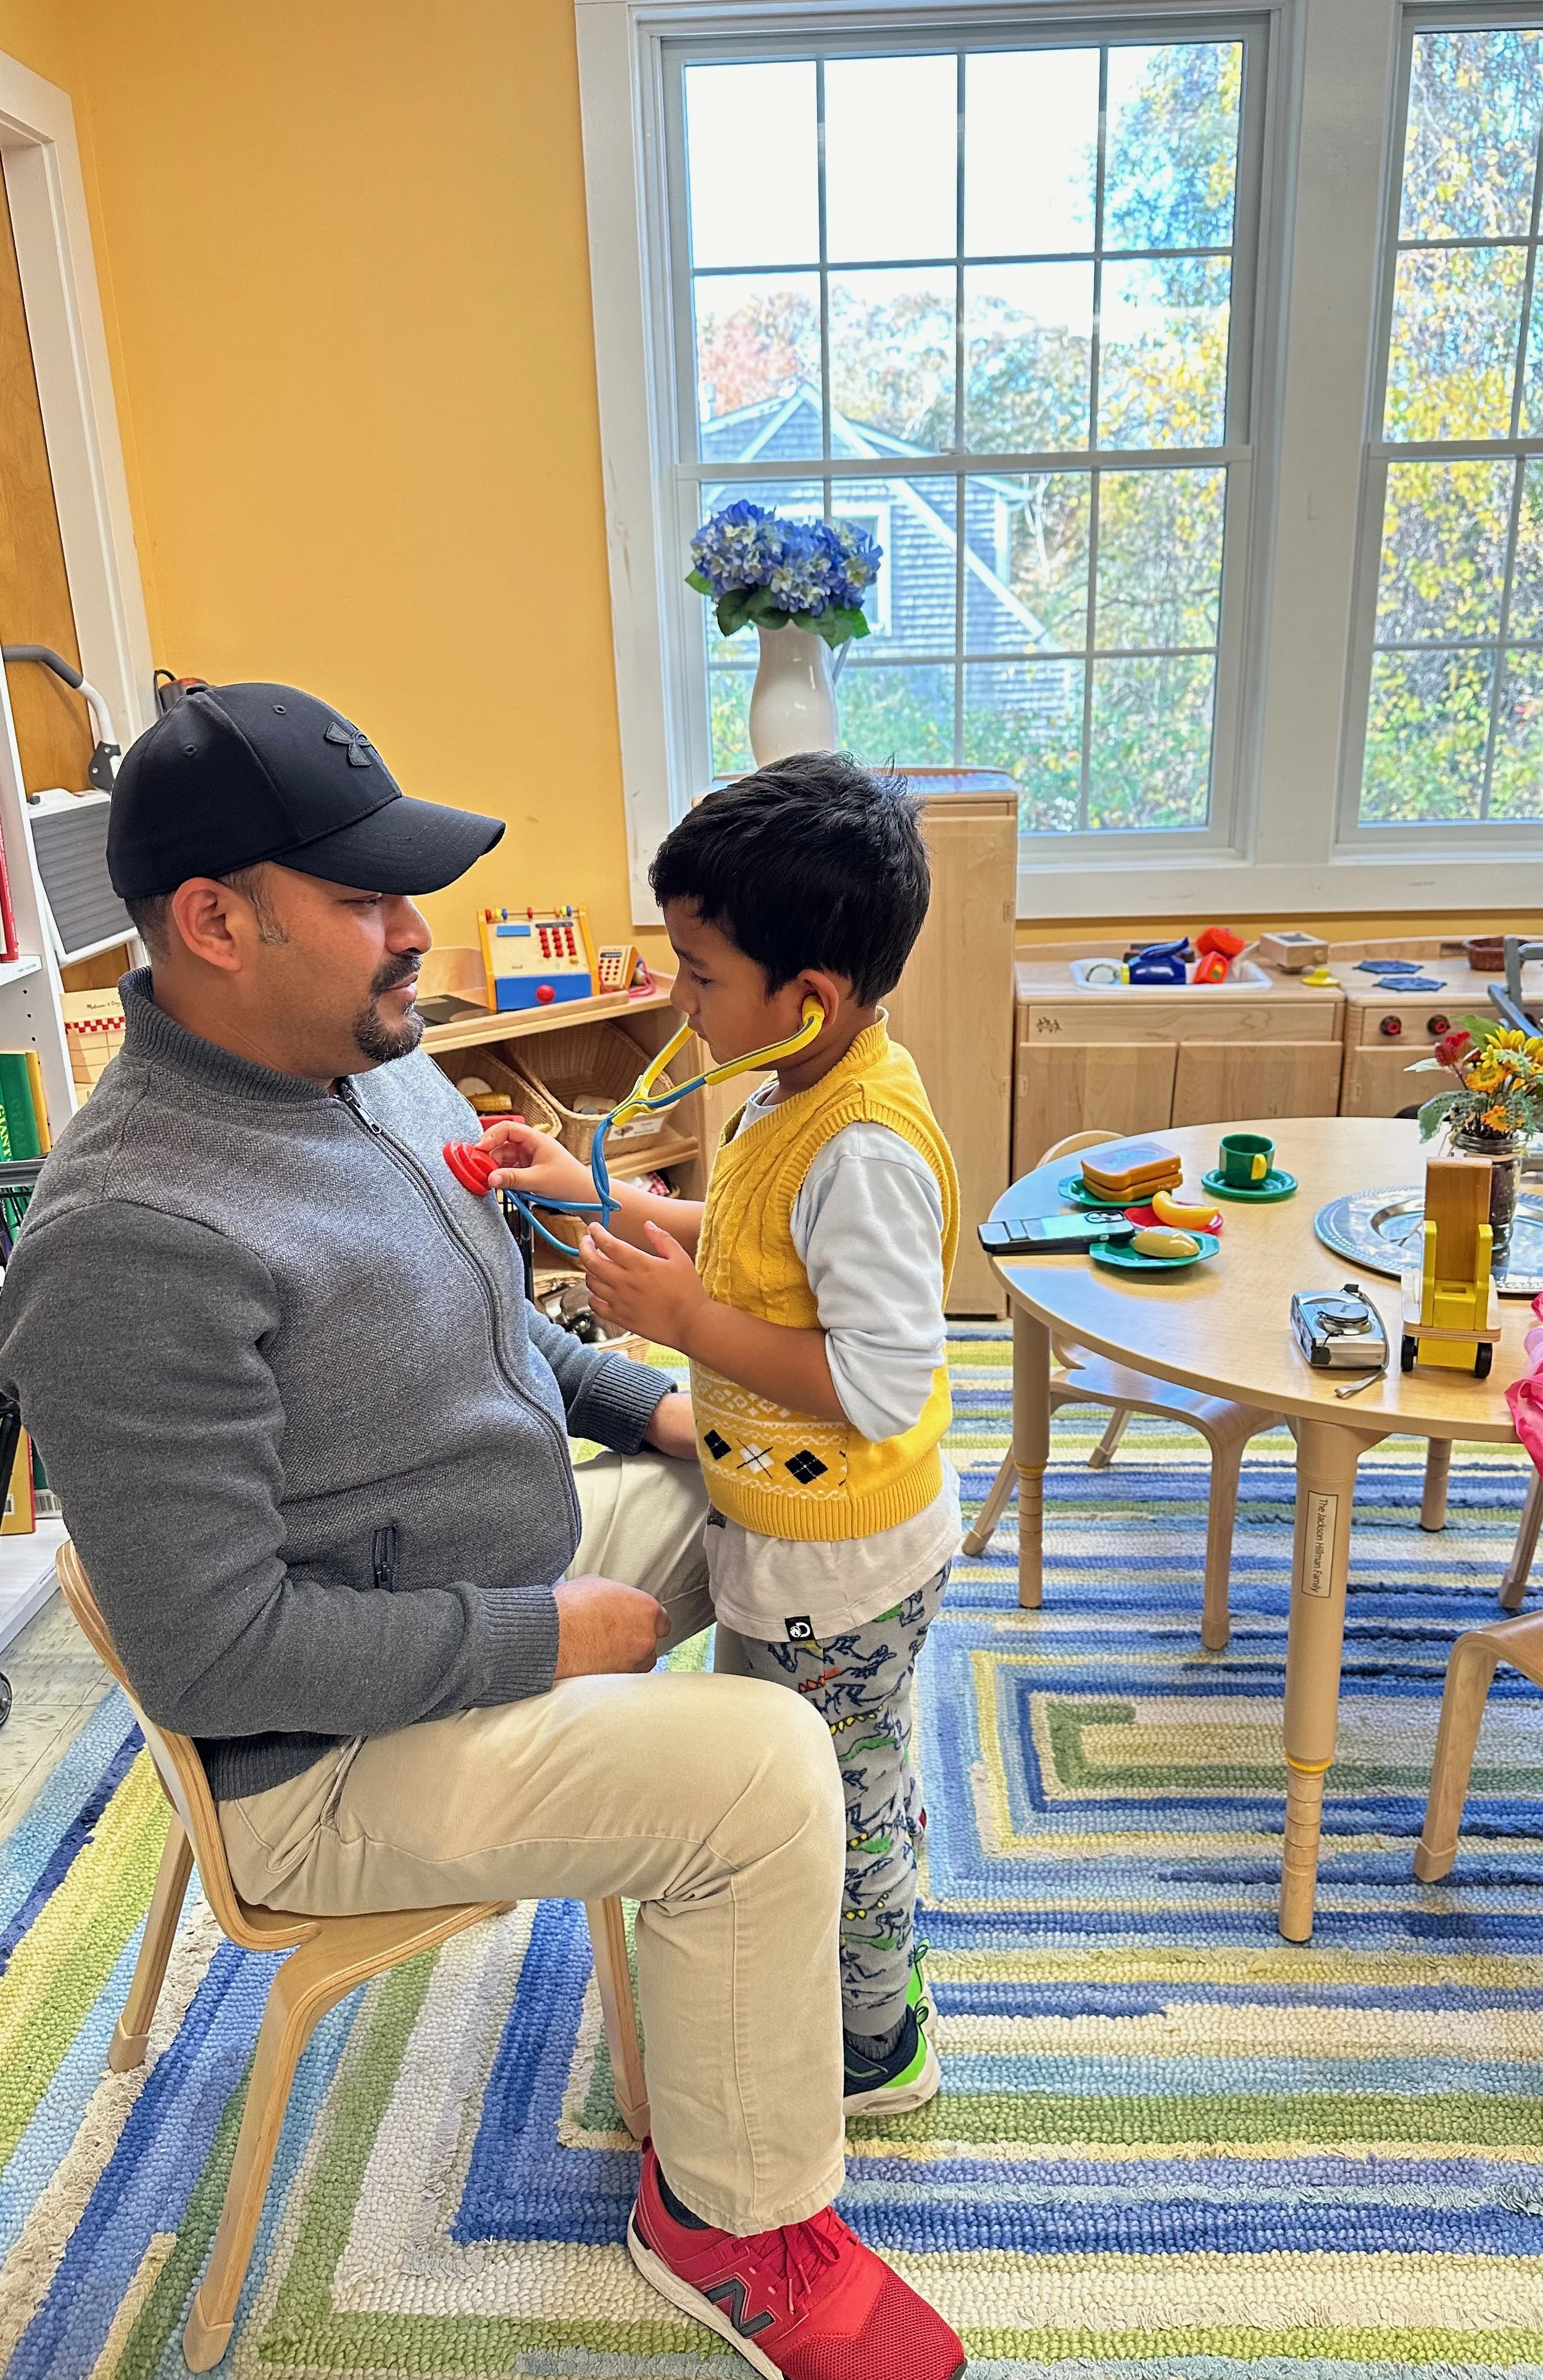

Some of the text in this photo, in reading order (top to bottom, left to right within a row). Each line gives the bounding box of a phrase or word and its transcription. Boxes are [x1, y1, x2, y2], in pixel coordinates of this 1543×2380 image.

[1310, 1498, 1328, 1593] The Jackson Hillman Family
